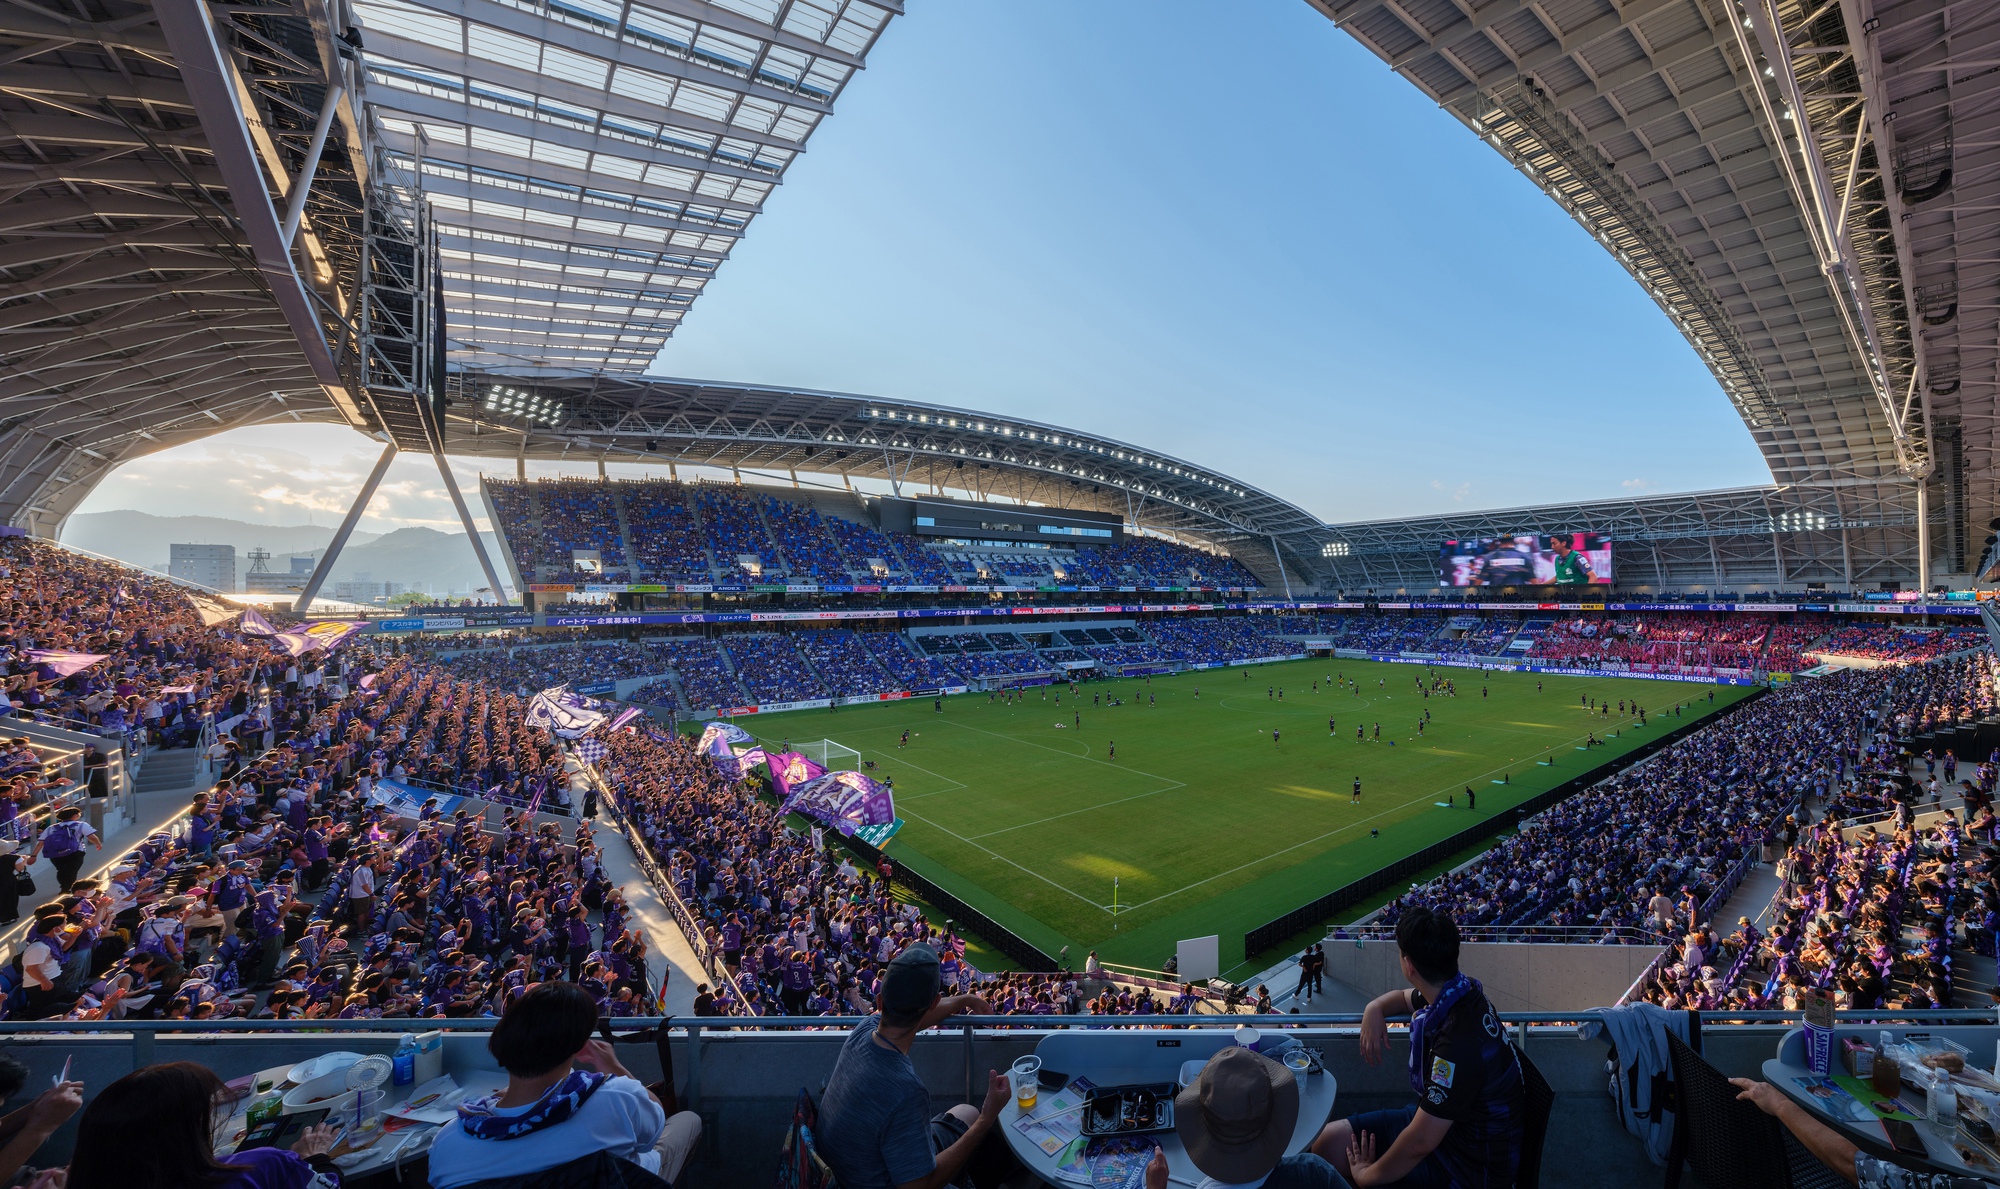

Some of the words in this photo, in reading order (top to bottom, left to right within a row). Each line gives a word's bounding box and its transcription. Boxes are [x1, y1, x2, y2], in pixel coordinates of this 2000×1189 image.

[1618, 671, 1655, 679] HIROSHIMA
[1656, 673, 1683, 681] SOCCER
[1684, 675, 1716, 683] MUSEUM
[857, 693, 880, 702] 中国電力
[770, 703, 793, 711] 大成建設
[1816, 1032, 1828, 1074] SANFRECCE
